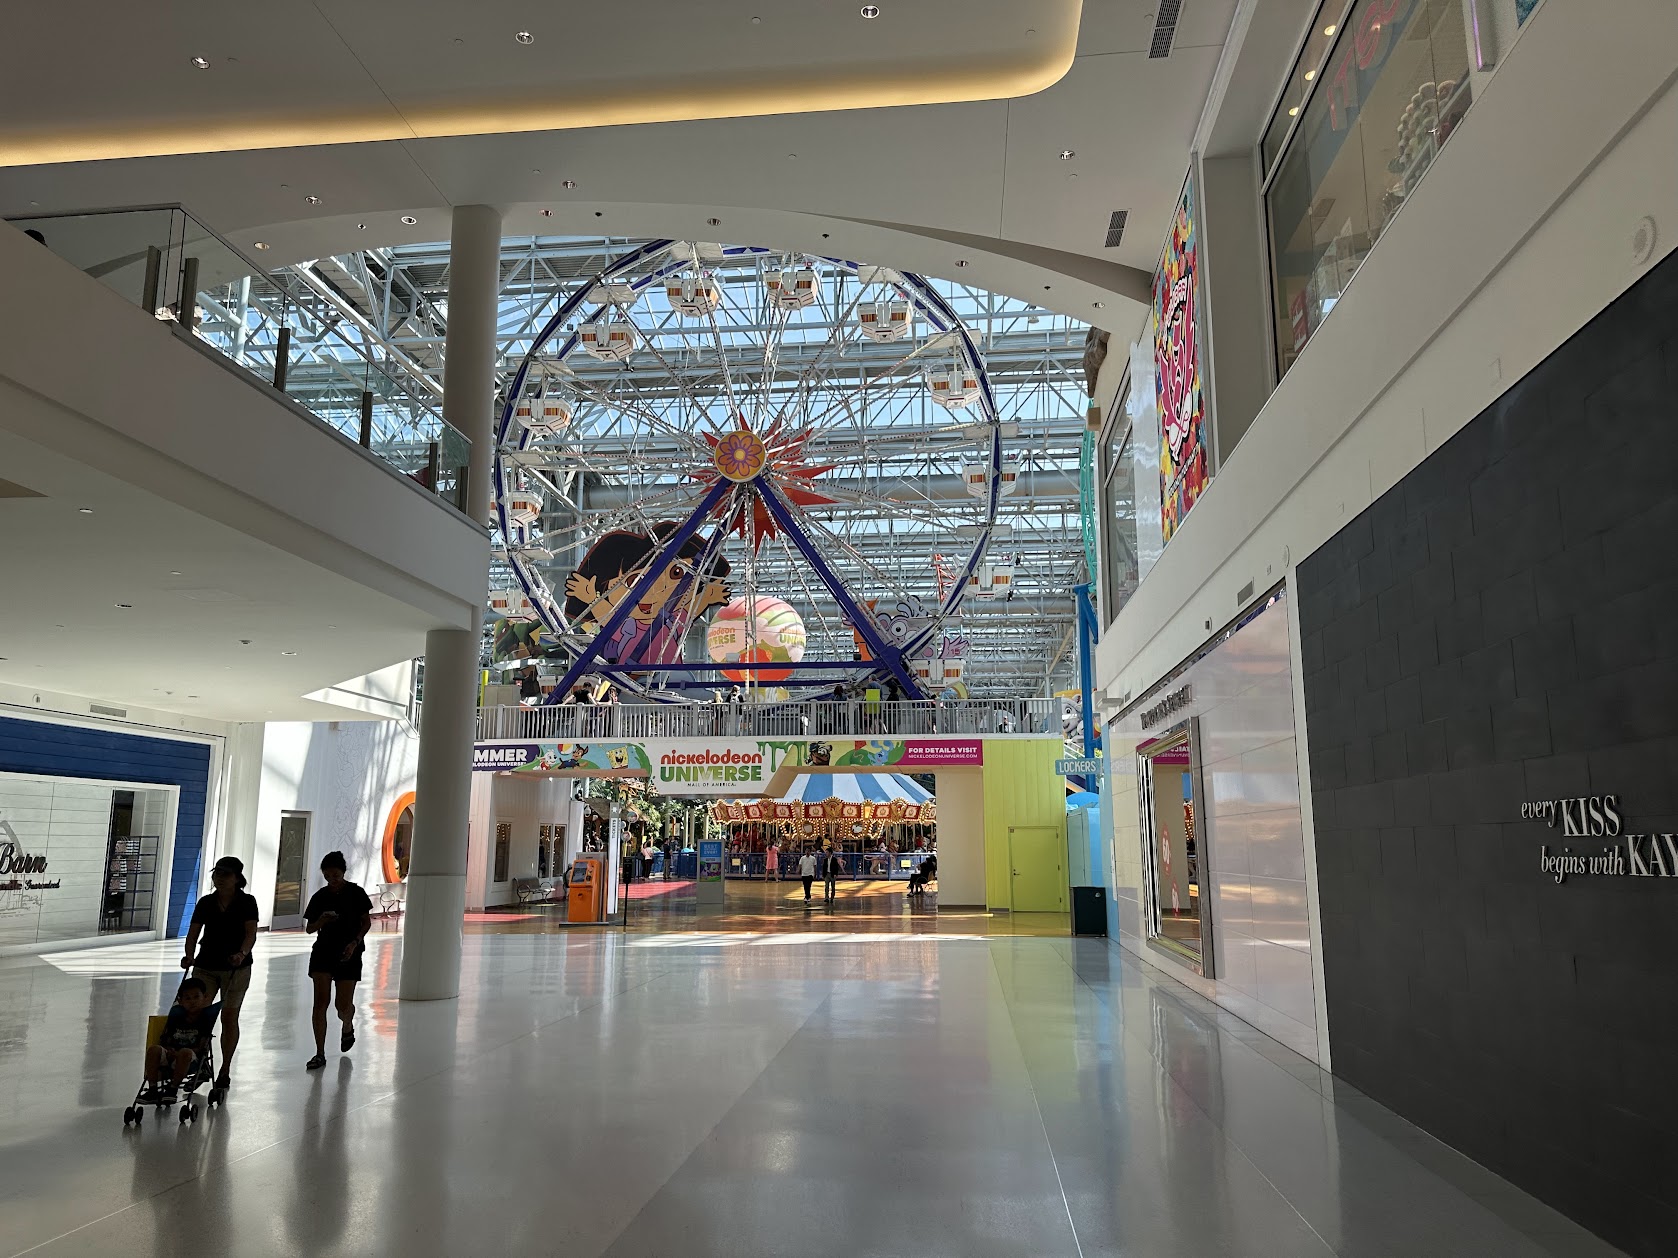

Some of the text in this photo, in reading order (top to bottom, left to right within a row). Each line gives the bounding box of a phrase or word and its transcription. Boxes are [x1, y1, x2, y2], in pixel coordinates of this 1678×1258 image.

[660, 748, 763, 765] nickelodeon
[660, 765, 762, 782] UNIVERSE
[1059, 760, 1097, 773] LOCKERS
[1521, 795, 1620, 837] every KISS
[1541, 845, 1586, 884] begins
[1589, 845, 1625, 876] with
